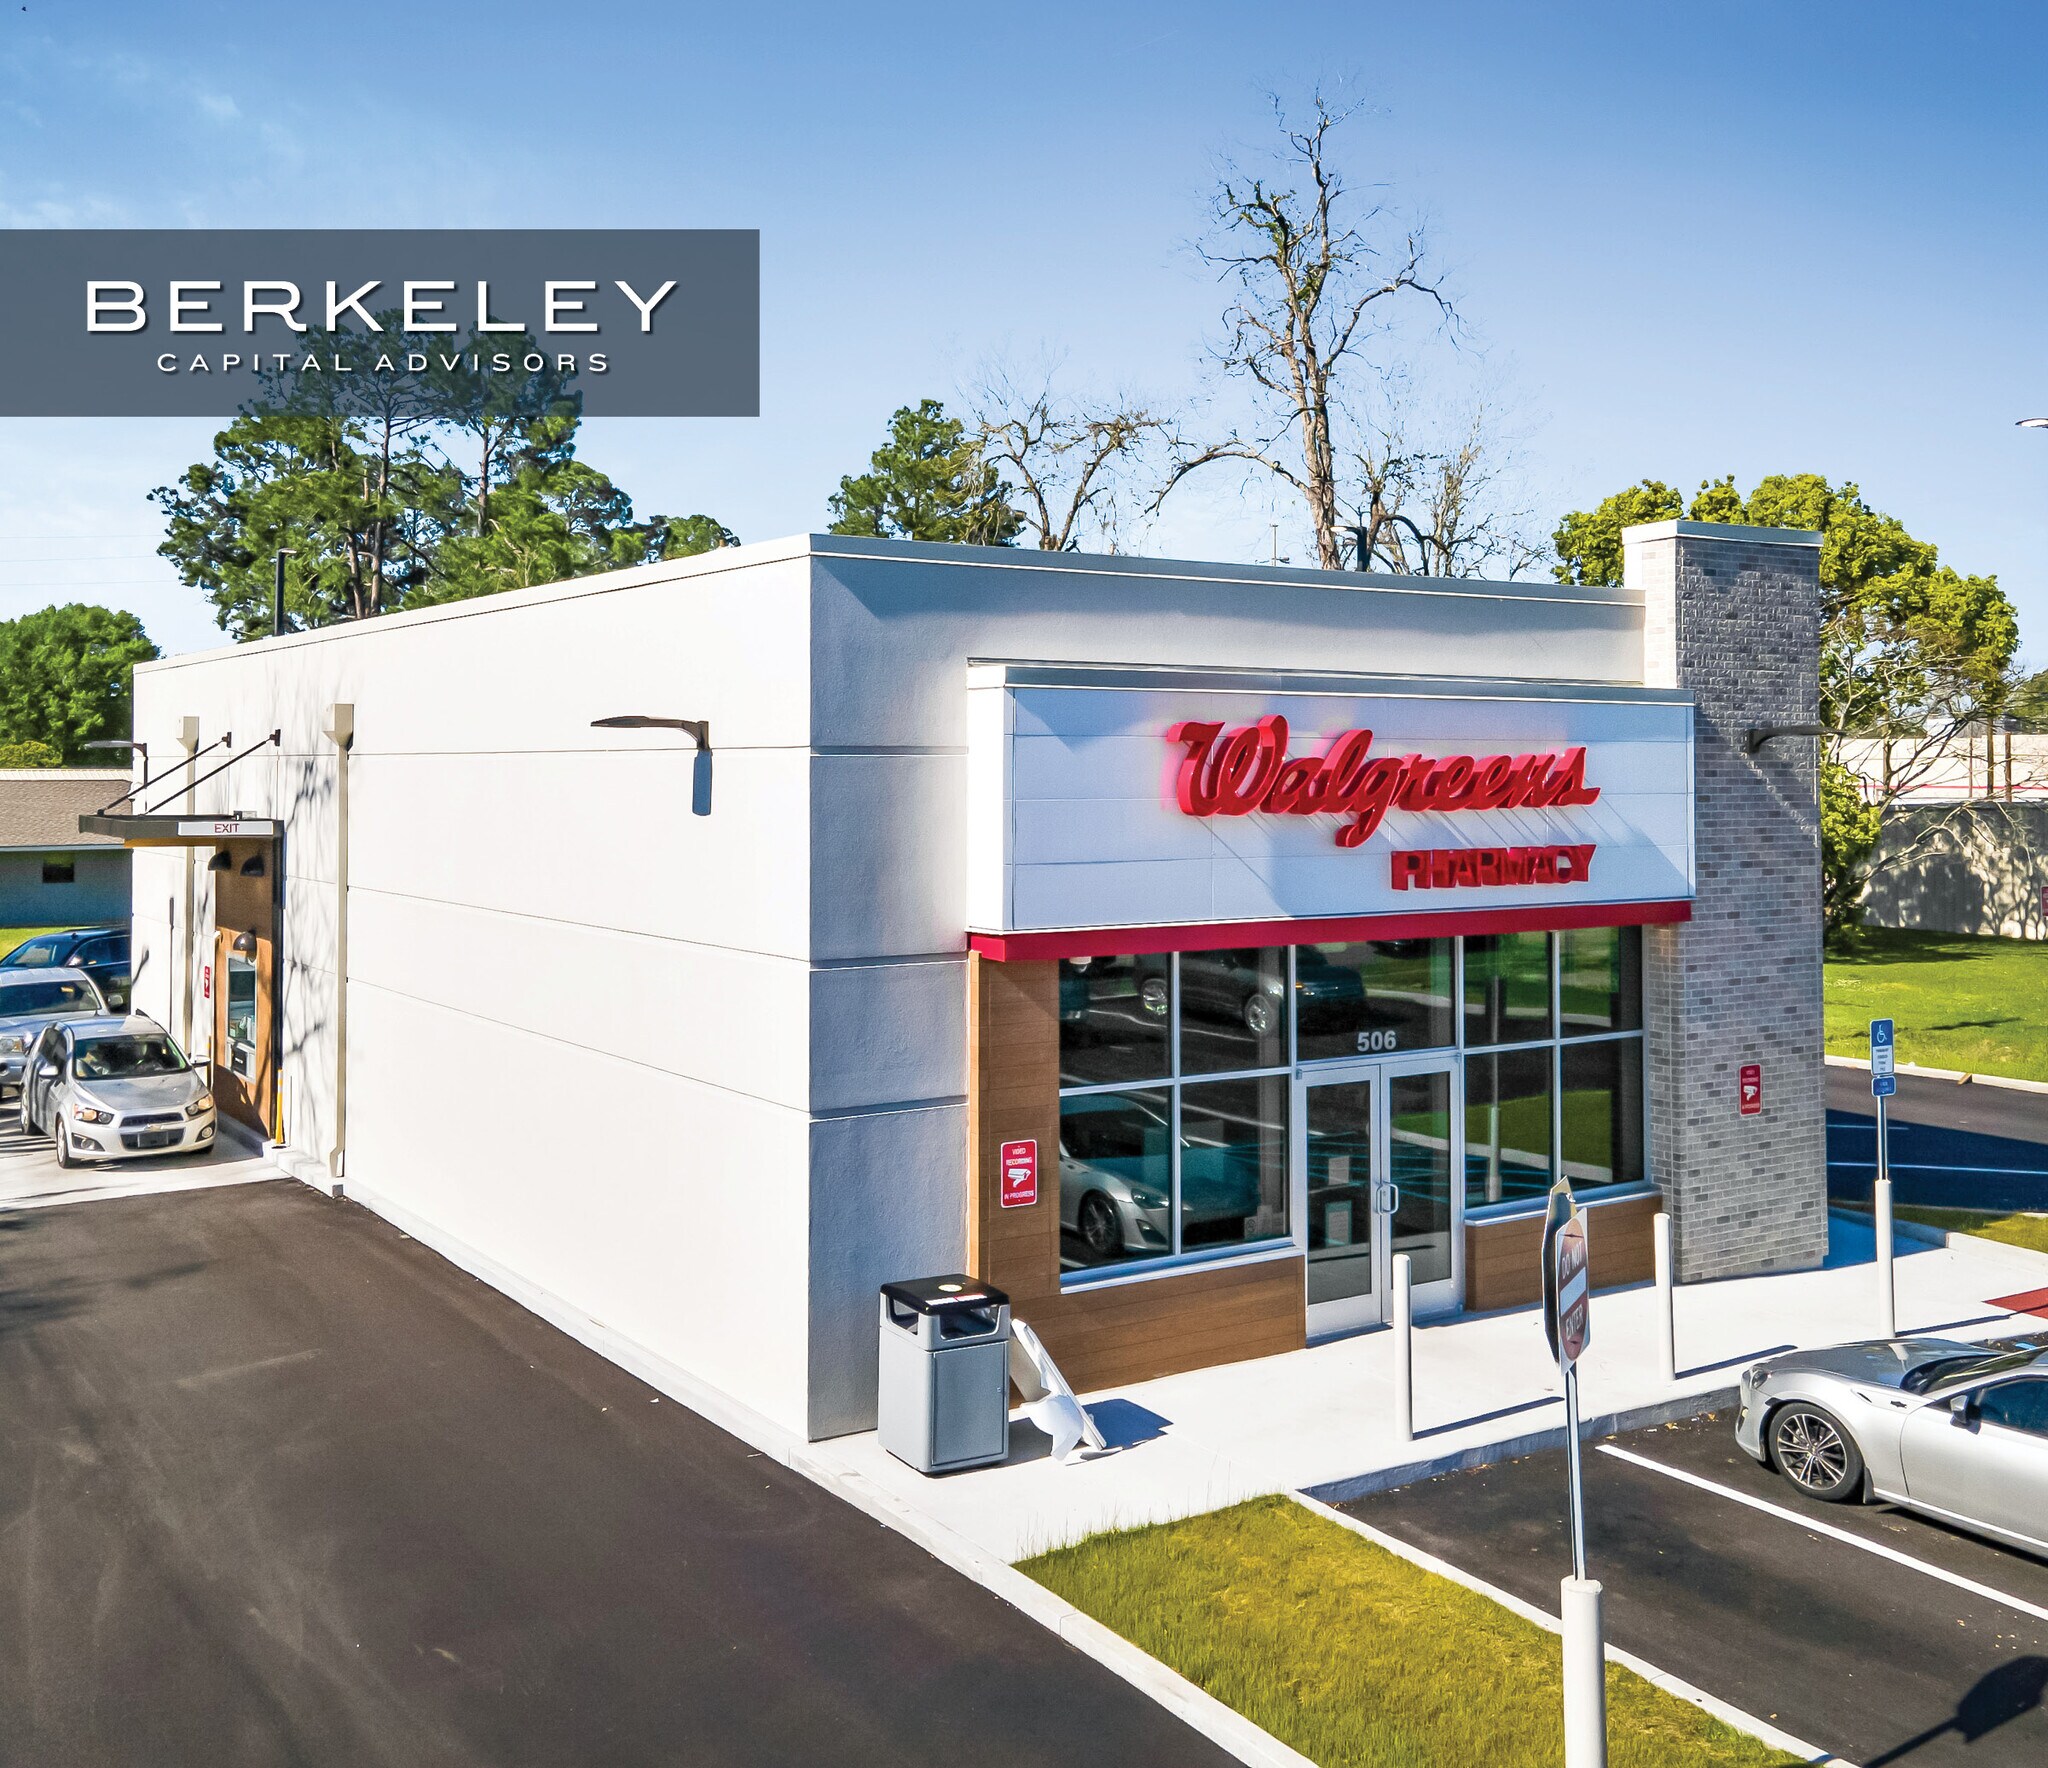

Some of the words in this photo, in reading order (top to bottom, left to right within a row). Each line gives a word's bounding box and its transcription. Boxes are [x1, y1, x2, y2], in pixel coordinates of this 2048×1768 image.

[1167, 714, 1601, 848] Walgreens
[214, 823, 240, 833] EXIT
[1391, 844, 1597, 890] PHARMACY
[1357, 1030, 1397, 1052] 506
[1561, 1254, 1570, 1279] DO
[1571, 1241, 1582, 1270] NOT
[1565, 1304, 1584, 1341] ENTER
